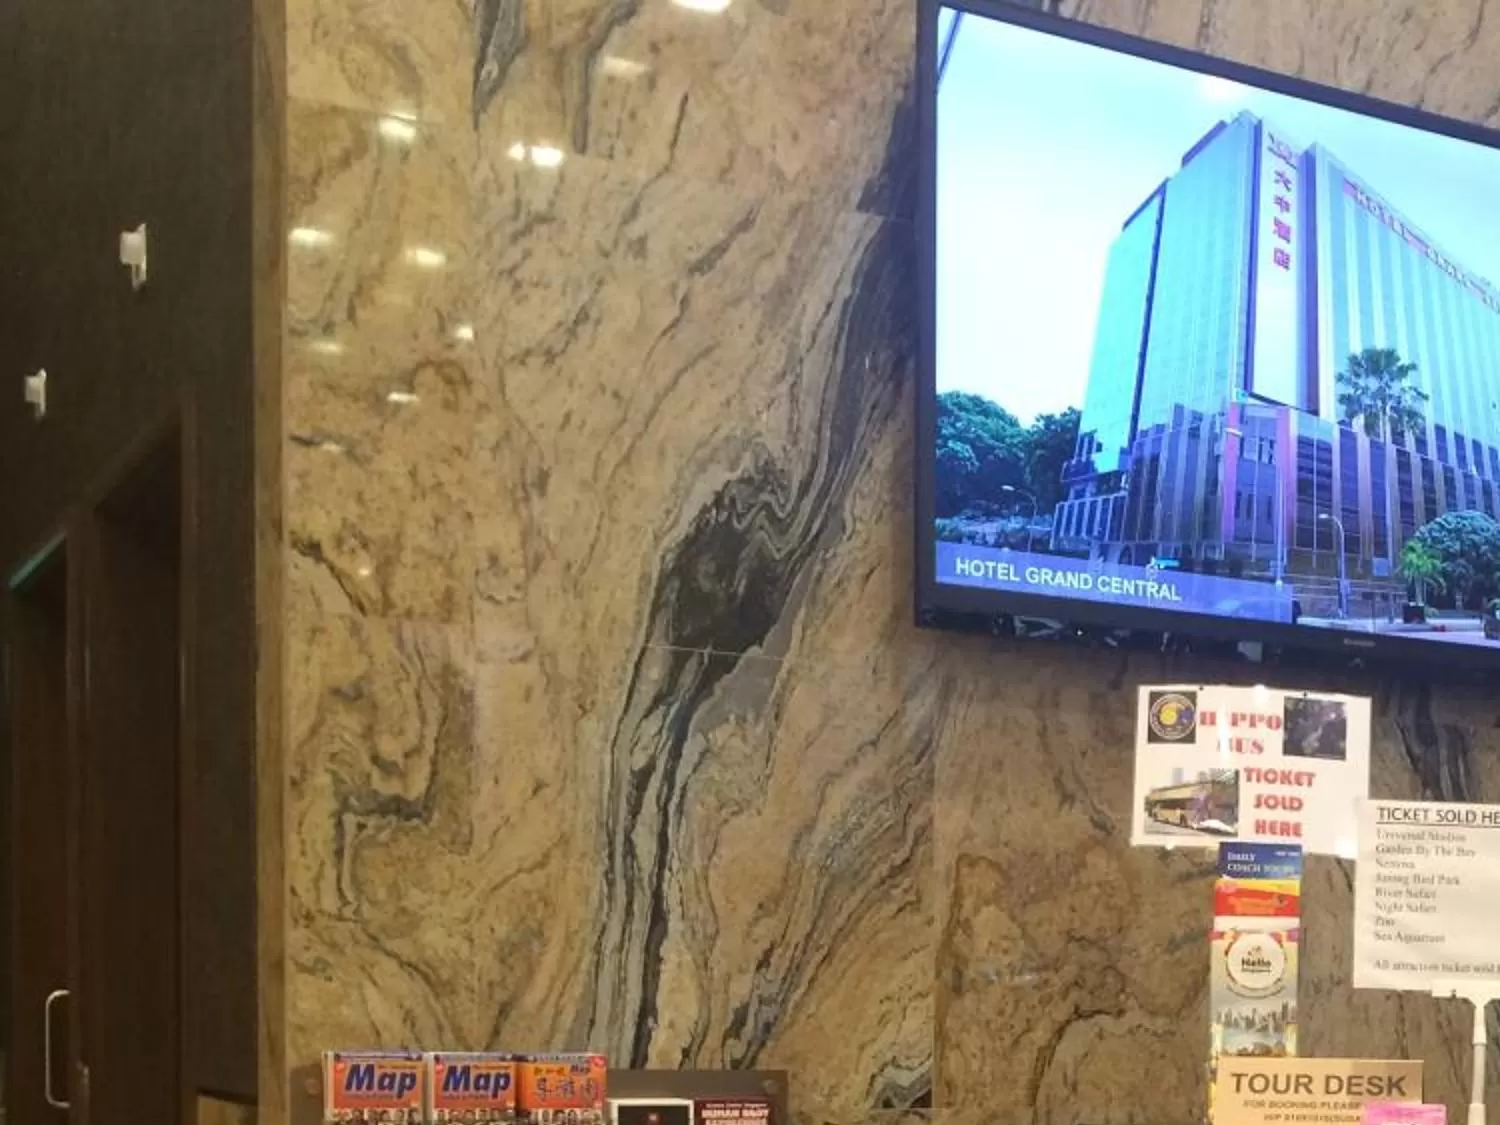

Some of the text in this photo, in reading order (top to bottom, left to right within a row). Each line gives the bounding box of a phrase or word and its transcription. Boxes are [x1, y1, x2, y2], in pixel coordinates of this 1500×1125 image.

[956, 556, 1183, 602] HOTEL GRAND CENTRAL
[1199, 710, 1283, 732] HPPO
[1243, 766, 1317, 788] TICKET
[1252, 793, 1304, 812] SOLD
[1376, 806, 1430, 822] TICKET
[1435, 809, 1477, 824] SOLD
[1254, 818, 1303, 838] HERE
[344, 1063, 418, 1099] Map
[441, 1062, 512, 1100] Map
[1230, 1072, 1408, 1098] TOUR DESK
